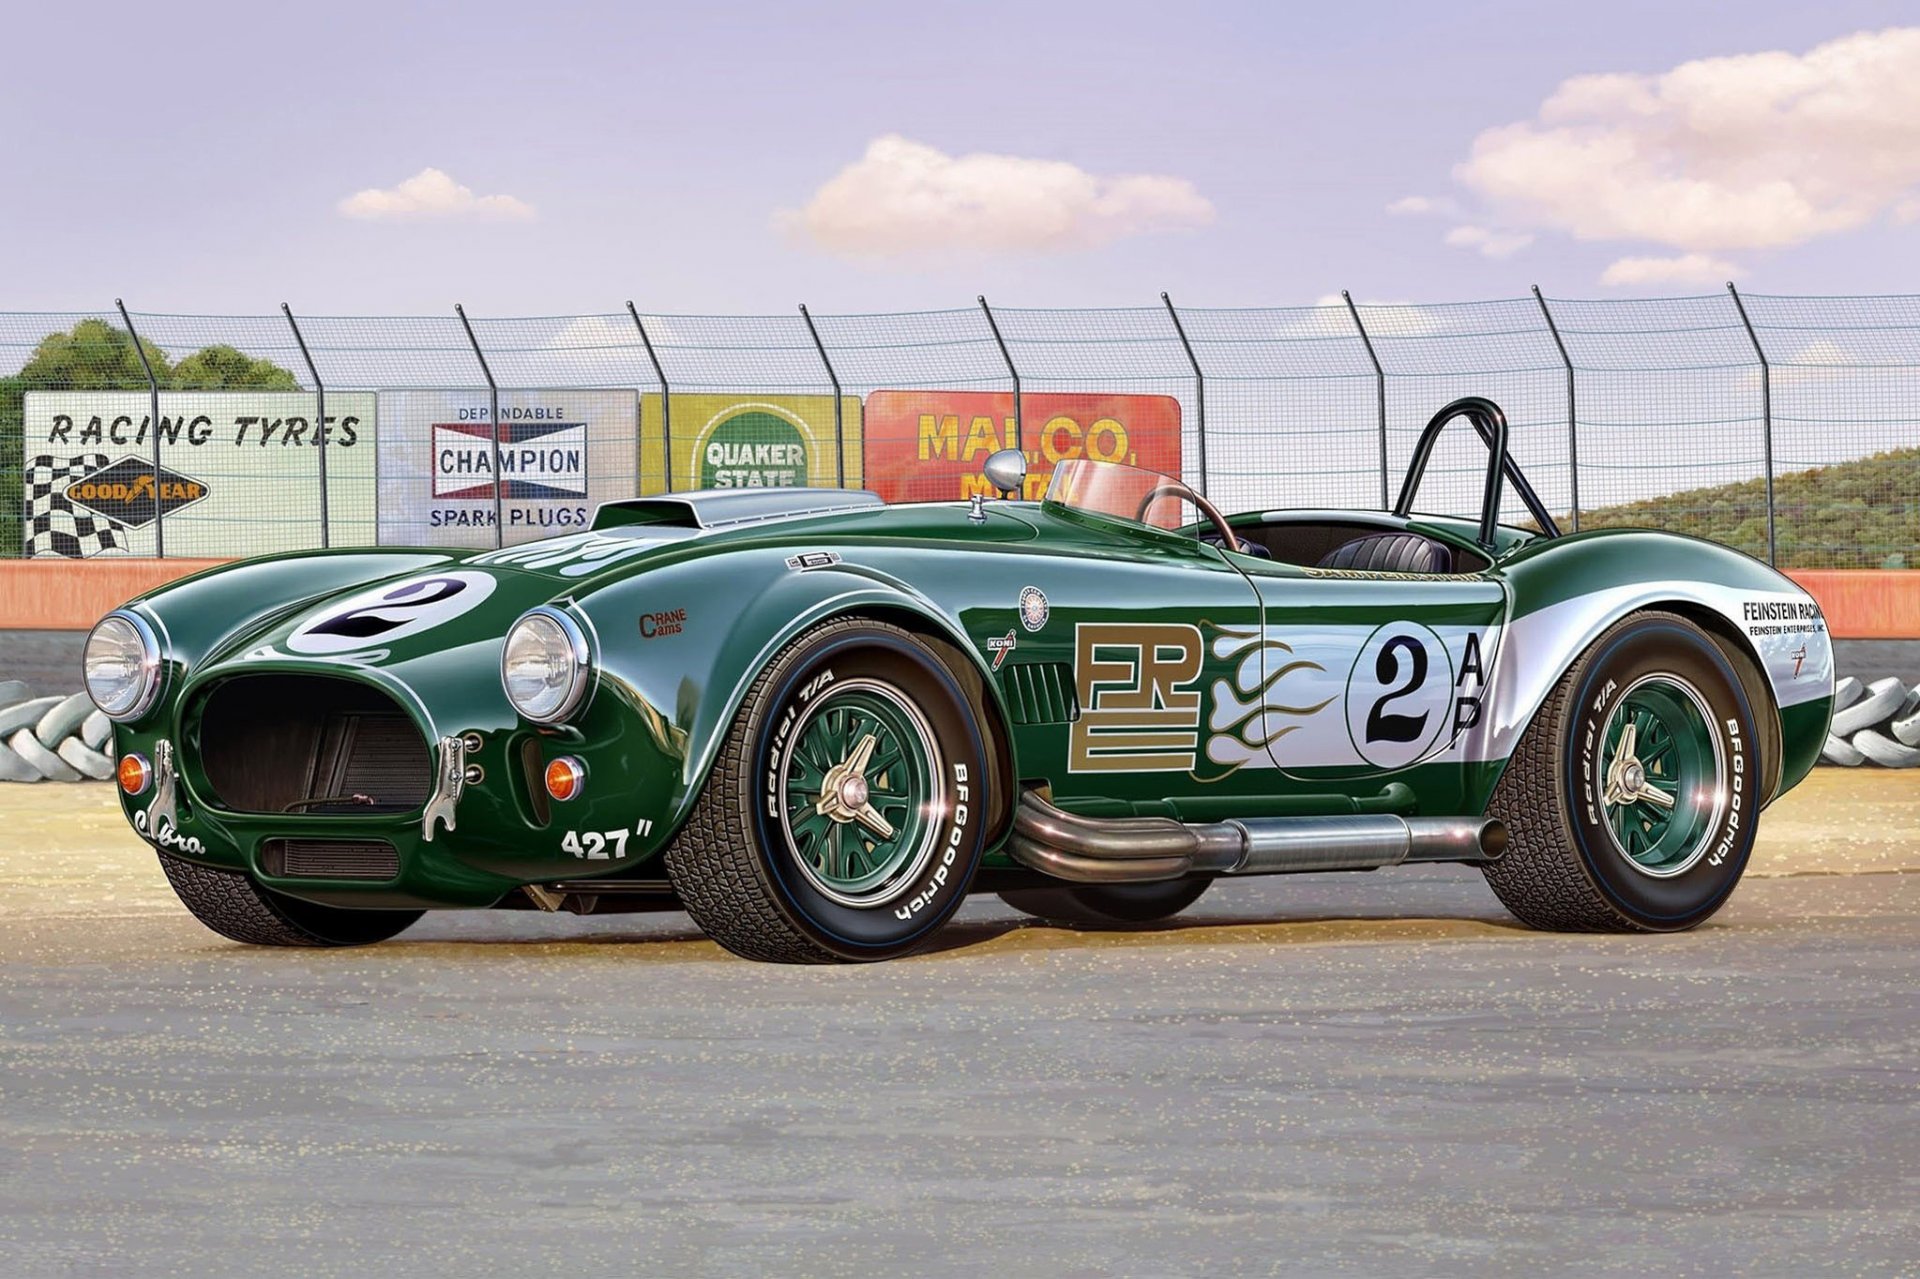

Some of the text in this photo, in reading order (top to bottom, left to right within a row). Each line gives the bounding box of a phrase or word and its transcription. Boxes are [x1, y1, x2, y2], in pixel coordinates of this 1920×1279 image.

[459, 407, 564, 420] DEPNDABLE
[48, 414, 360, 447] RACING TYRES
[440, 449, 580, 474] CHAMPION
[706, 442, 804, 468] QUAKER
[714, 469, 796, 489] STATE
[430, 507, 588, 528] SPARK PLUGS
[302, 578, 468, 638] 2
[1743, 602, 1798, 621] FEINSTEIN
[1749, 625, 1782, 636] FEINSTEIN
[1366, 635, 1430, 744] 2
[768, 668, 835, 818] Radial T/A
[1583, 678, 1618, 825] Radial T/A
[1708, 718, 1744, 867] BFGoodrich
[134, 809, 206, 854] Cbra
[894, 763, 969, 920] BFGoodrich
